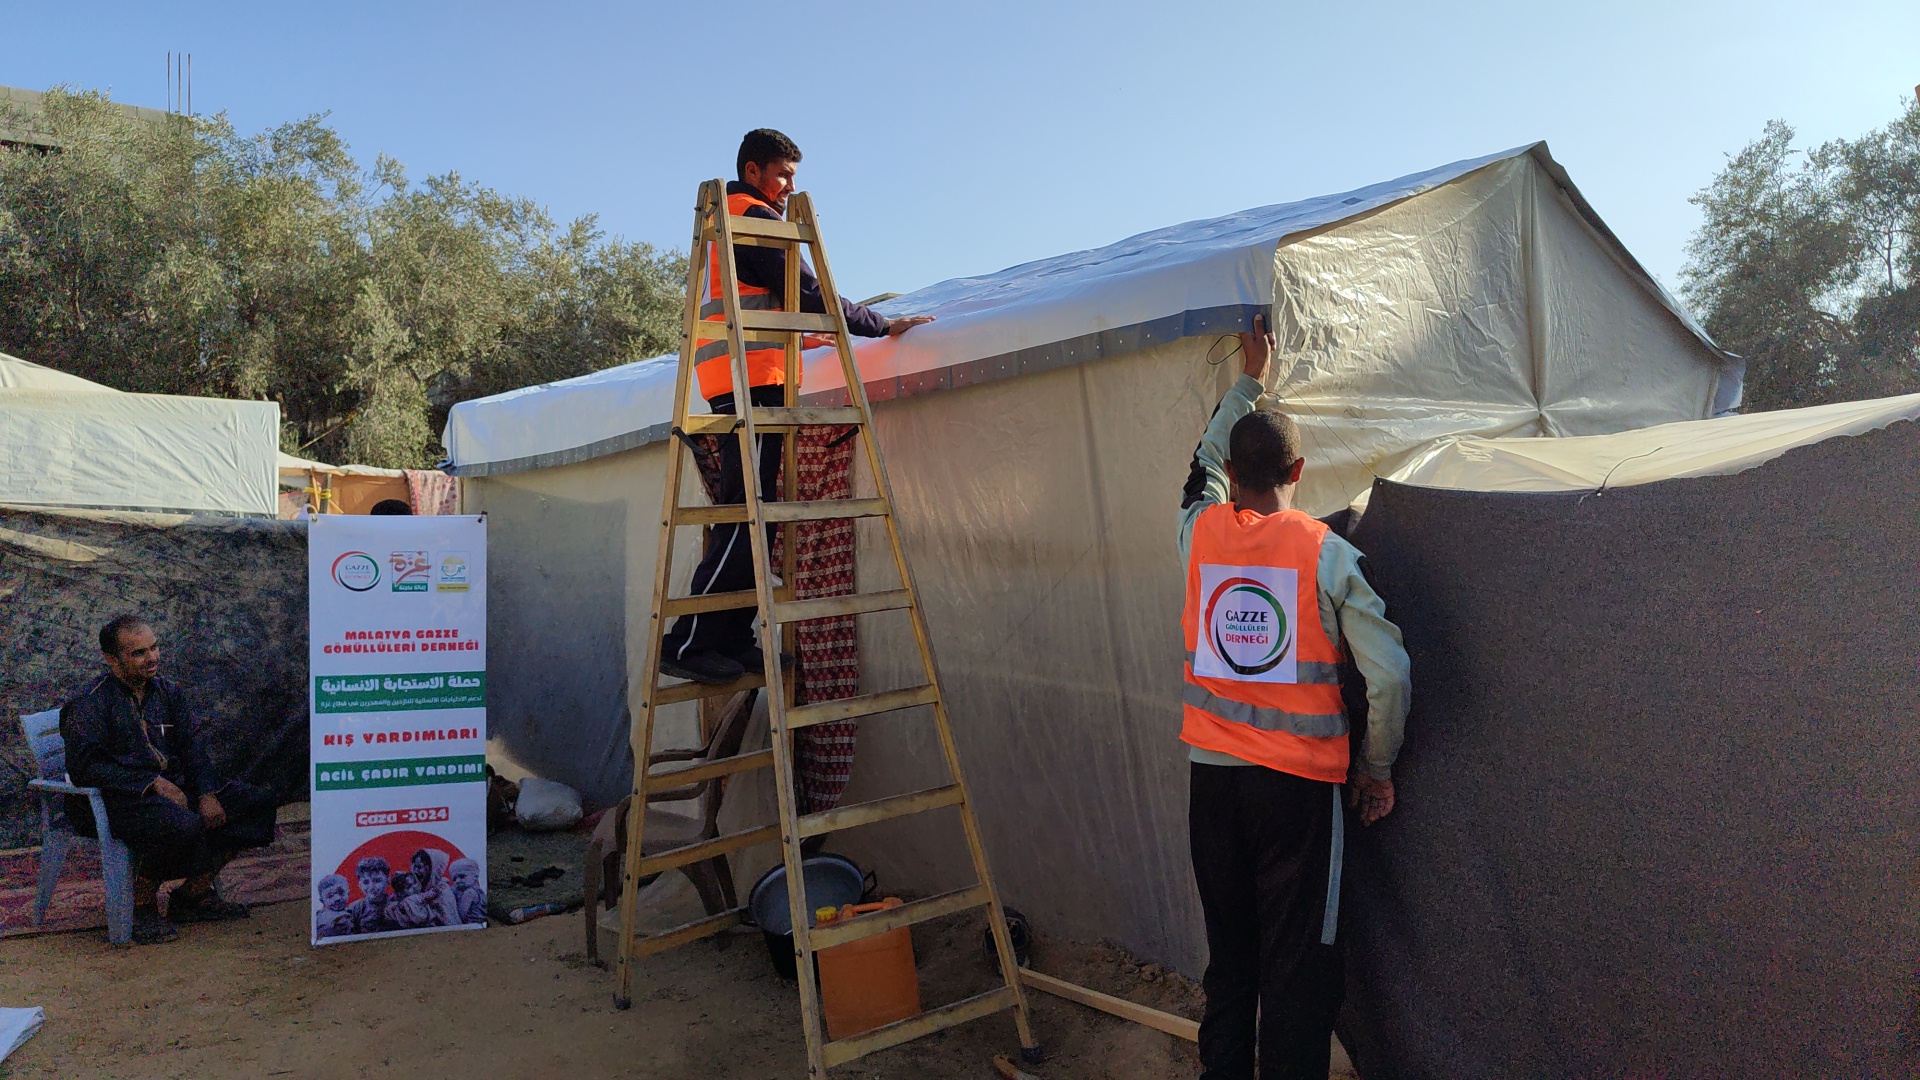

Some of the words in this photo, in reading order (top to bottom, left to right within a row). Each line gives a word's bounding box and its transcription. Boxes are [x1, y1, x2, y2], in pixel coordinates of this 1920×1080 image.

[1225, 609, 1269, 623] GAZZE
[416, 629, 459, 639] GAZZE
[1225, 633, 1269, 644] DERNEĞİ
[323, 641, 416, 654] GÖNÜLLÜLERİ
[421, 639, 479, 652] DERNEĞİ
[321, 678, 380, 695] الانسانية
[383, 676, 444, 693] الاستجابة
[447, 675, 481, 688] حملة
[323, 733, 354, 748] KIŞ
[320, 768, 355, 782] ACİL
[361, 767, 409, 782] ÇADIR
[357, 812, 397, 826] Gaza
